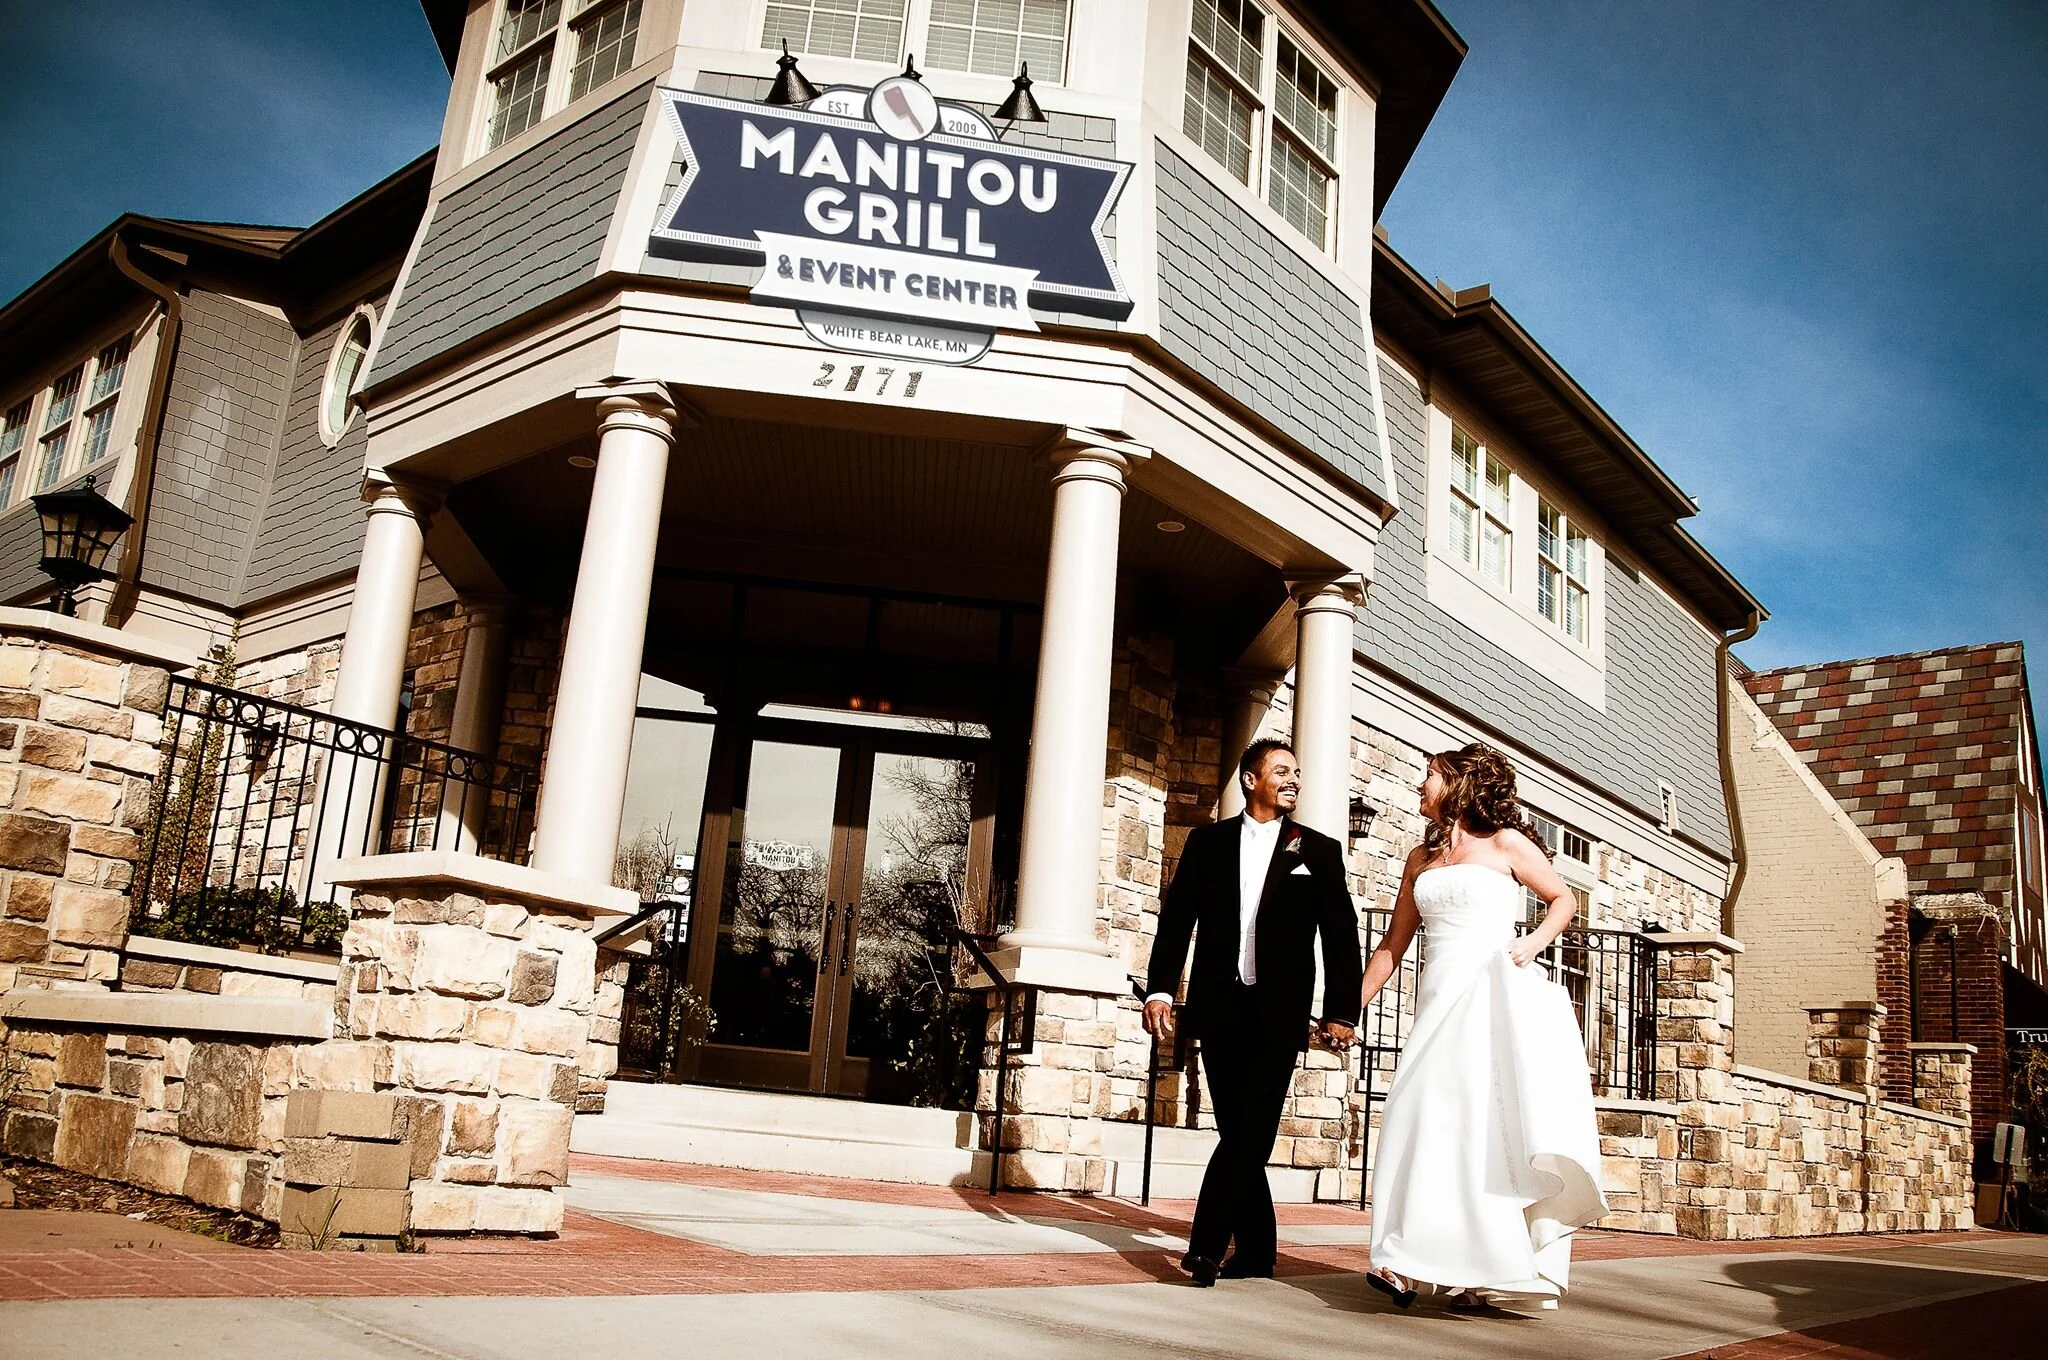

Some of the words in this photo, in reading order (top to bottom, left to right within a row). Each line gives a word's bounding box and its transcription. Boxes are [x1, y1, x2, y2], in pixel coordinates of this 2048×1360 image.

[828, 100, 853, 115] EST.
[949, 120, 977, 135] 2009
[740, 120, 1058, 213] MANITOU
[803, 186, 997, 258] GRILL
[777, 254, 794, 280] &
[799, 257, 897, 294] EVENT
[905, 273, 1018, 311] CENTER
[822, 323, 865, 341] WHITE
[870, 330, 903, 346] BEAR
[907, 335, 943, 352] LAKE,
[946, 341, 968, 354] MN
[812, 360, 923, 398] 2171
[761, 854, 796, 864] MANITOU
[2016, 1031, 2048, 1043] Tru
